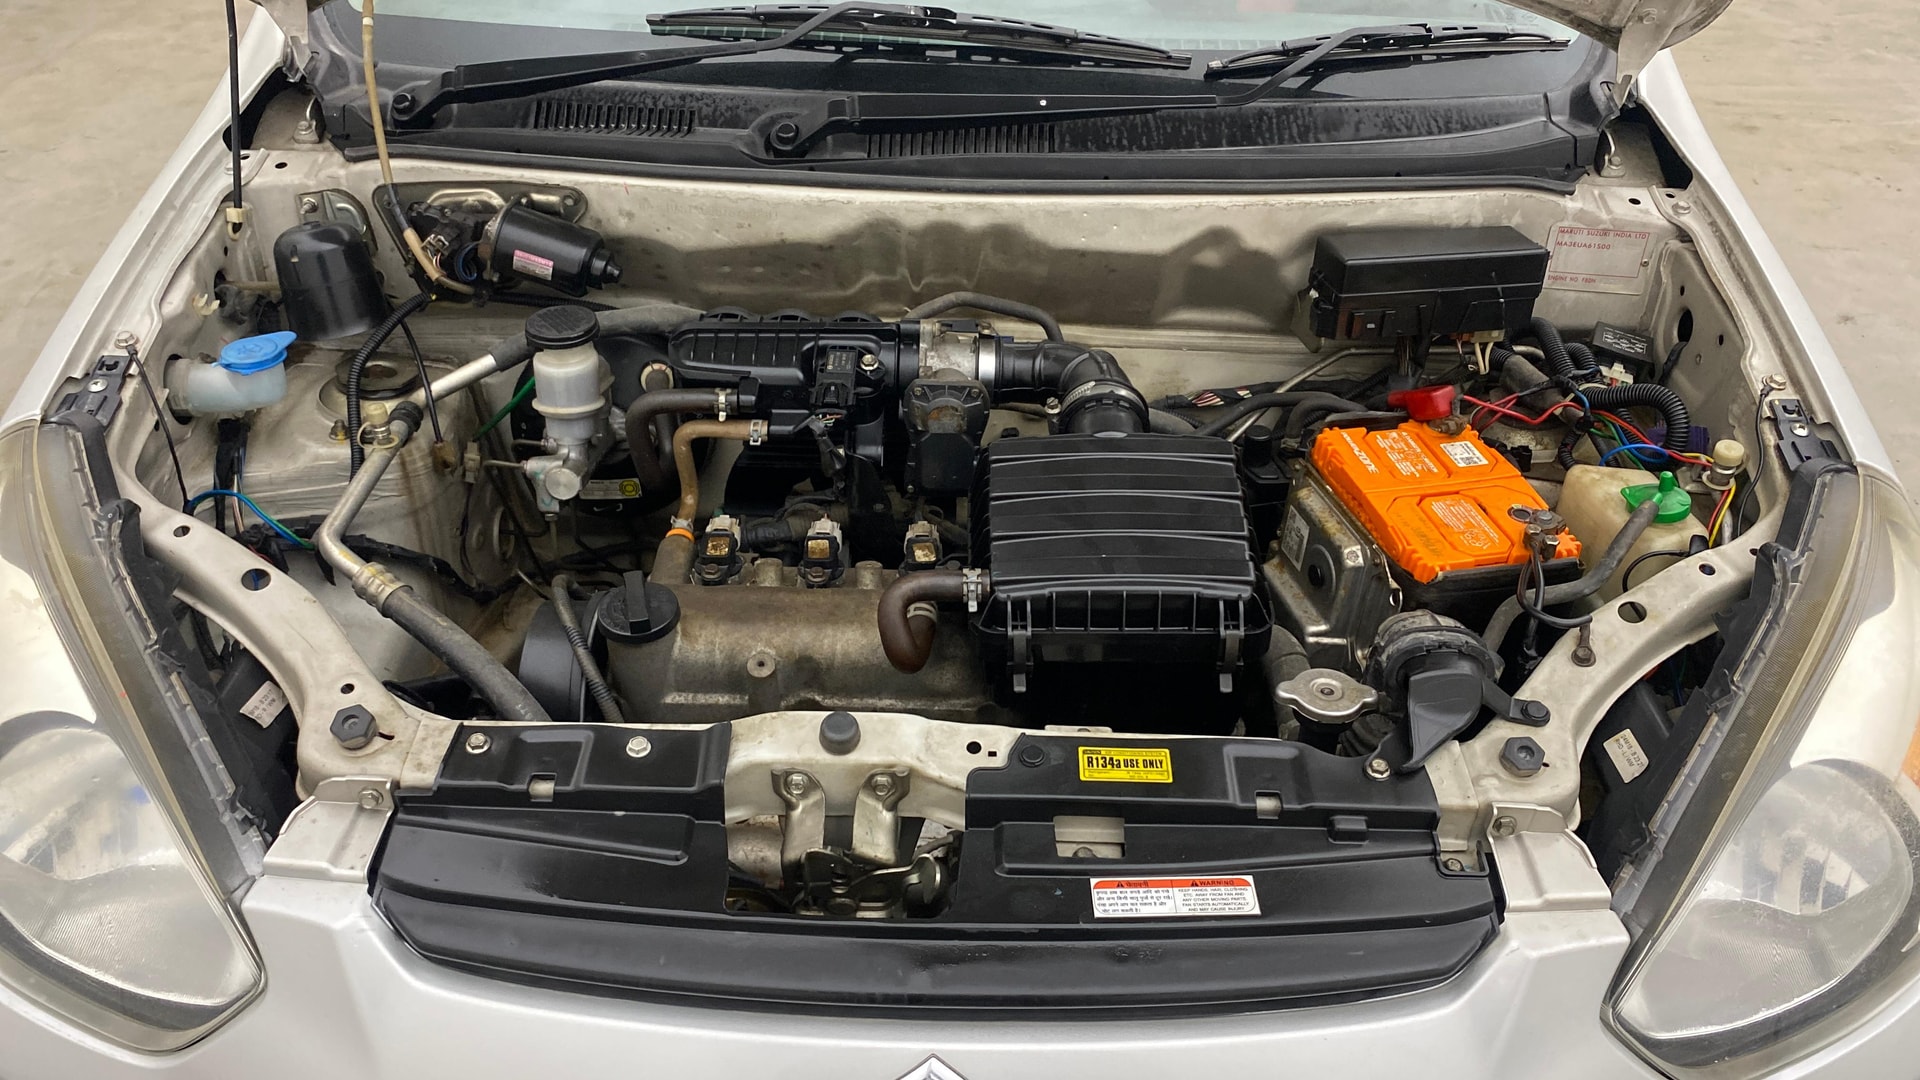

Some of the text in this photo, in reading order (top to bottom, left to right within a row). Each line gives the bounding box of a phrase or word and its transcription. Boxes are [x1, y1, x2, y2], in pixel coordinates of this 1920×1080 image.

[1556, 240, 1611, 250] MA3EUA61S00
[1087, 756, 1164, 769] R134a USE ONLY
